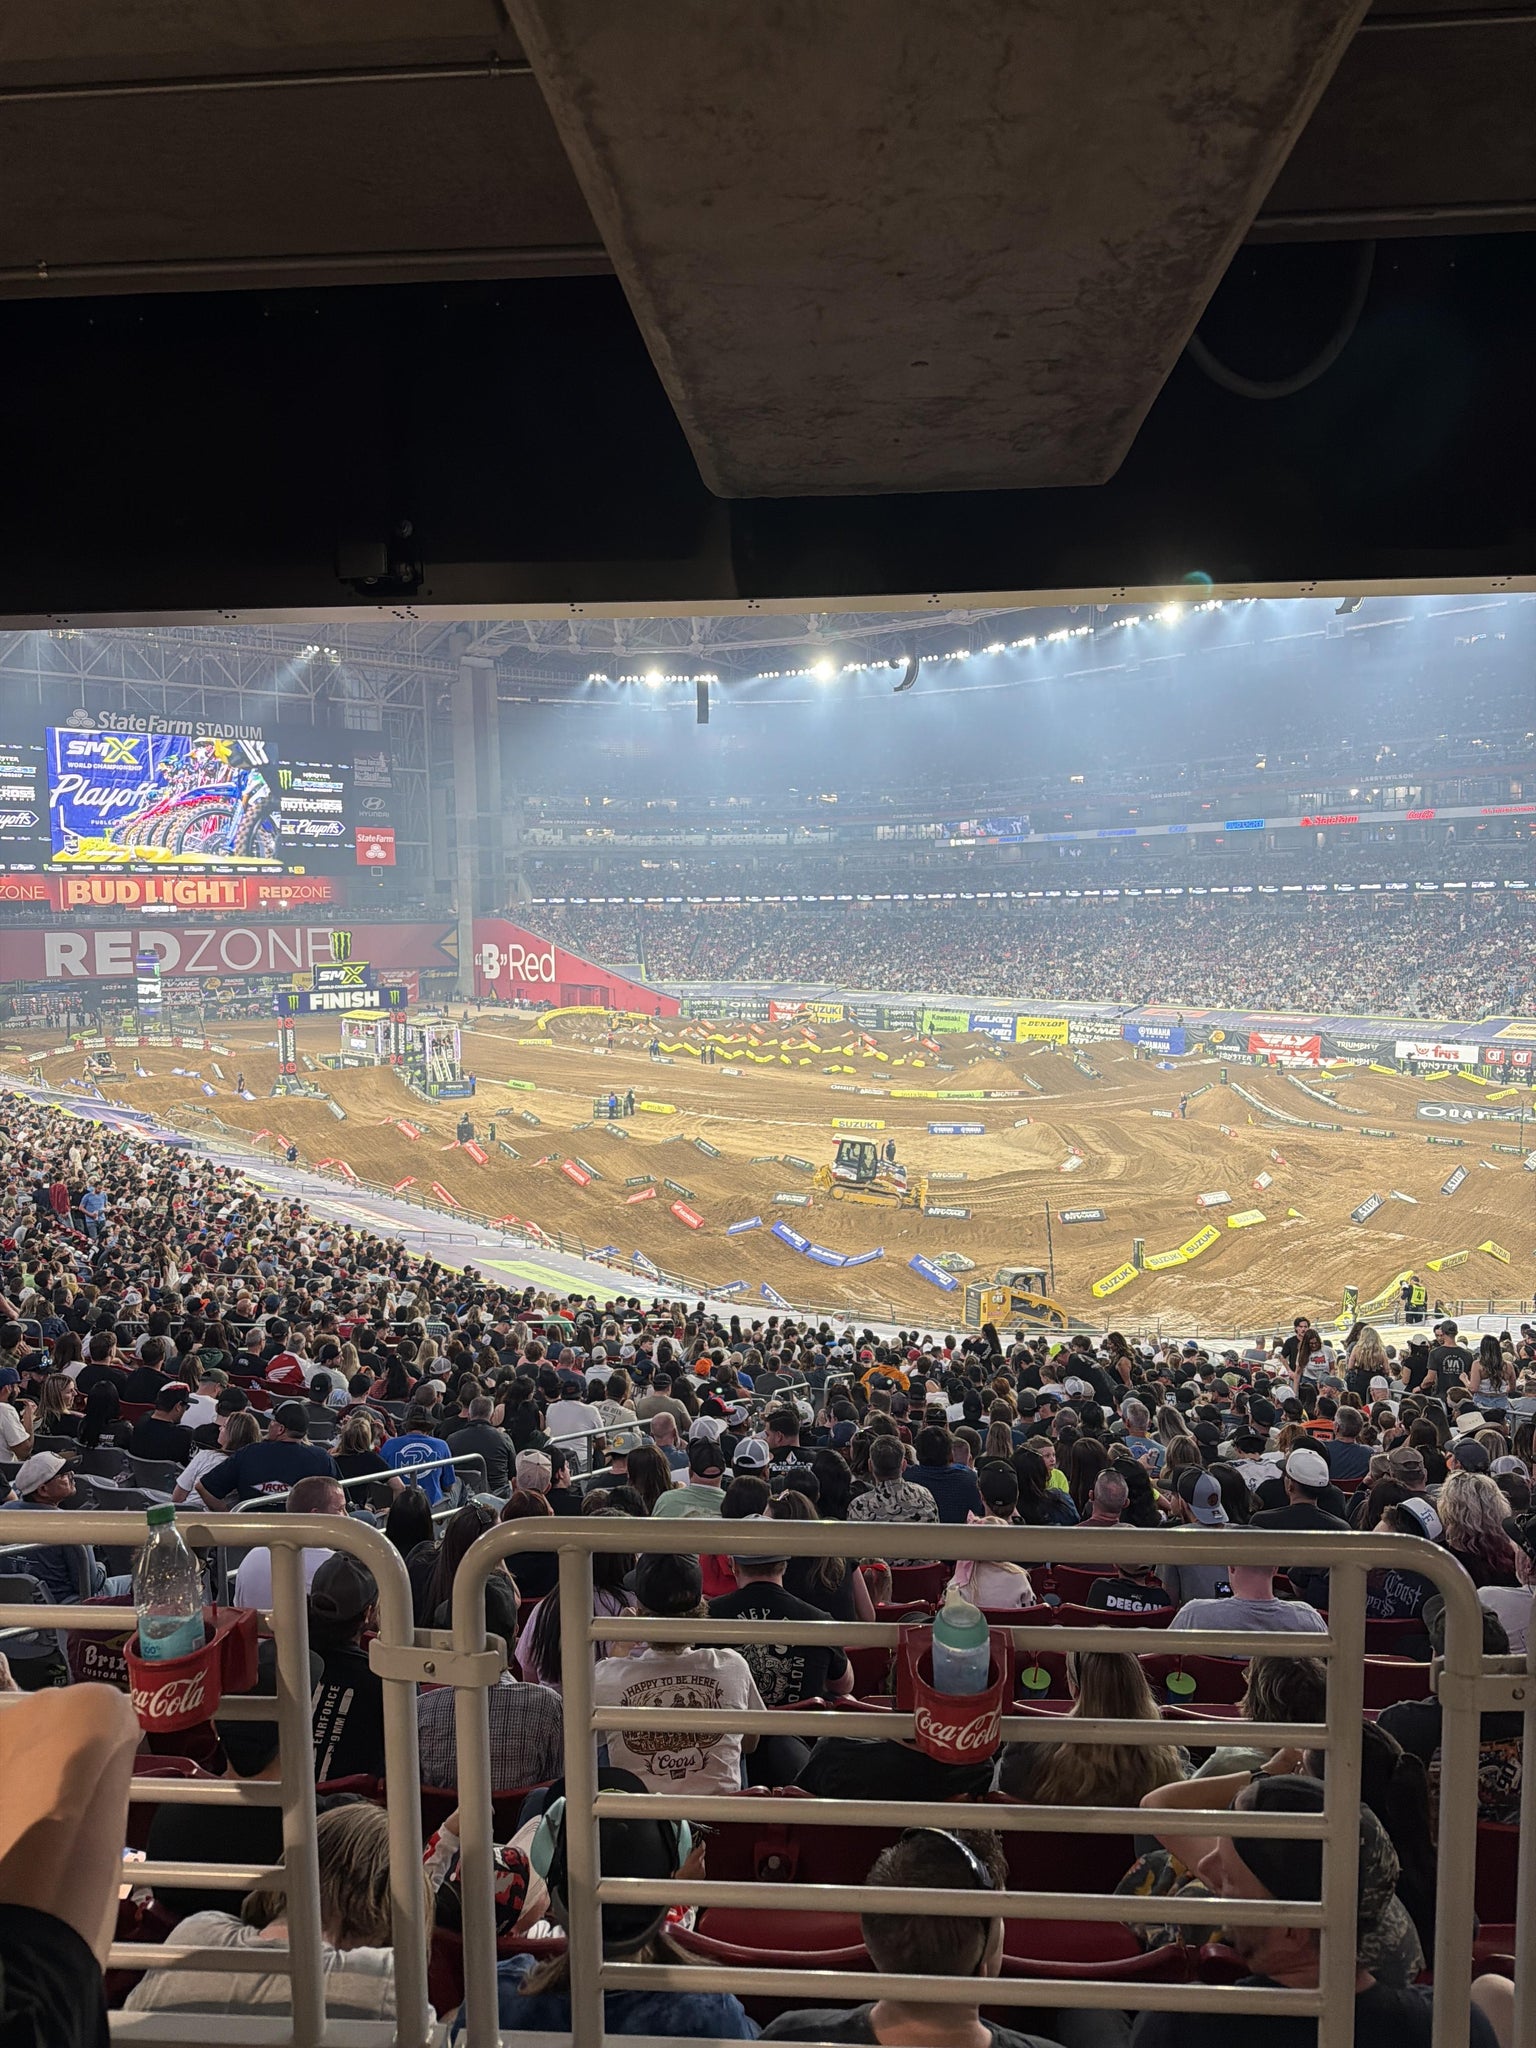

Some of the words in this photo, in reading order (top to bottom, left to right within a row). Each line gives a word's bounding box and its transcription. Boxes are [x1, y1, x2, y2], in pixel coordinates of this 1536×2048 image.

[97, 711, 193, 735] StateFarm
[196, 721, 262, 741] STADIUM
[66, 736, 140, 764] SMX
[93, 763, 143, 771] CHAMPIONSHIP
[1361, 774, 1383, 782] LARRY
[1385, 772, 1413, 780] WILSON
[1314, 814, 1359, 825] StateFarm
[296, 819, 340, 838] Playoffs
[357, 834, 394, 843] StateFarm
[67, 880, 140, 905] BUD
[259, 886, 332, 898] REDZONE
[44, 928, 334, 977] REDZONE
[509, 944, 556, 982] Red
[319, 966, 365, 984] SMX
[309, 990, 380, 1010] FINISH
[807, 1005, 842, 1015] SUZUKI
[931, 1014, 961, 1022] Kawasaki
[974, 1015, 1013, 1024] FALKEN
[1145, 1027, 1171, 1036] YAMAHA
[1258, 1033, 1315, 1046] FLY
[1336, 1041, 1370, 1050] TRIUMPH
[1432, 1045, 1460, 1060] fry's
[1487, 1051, 1503, 1061] QT
[1513, 1055, 1530, 1064] QT
[838, 1120, 878, 1129] SUZUKI
[568, 1166, 586, 1183] HONDA
[678, 1208, 698, 1225] HONDA
[1235, 1213, 1261, 1226] SUZUKI
[779, 1223, 806, 1244] FALKEN
[1186, 1228, 1216, 1254] SUZUKI
[1151, 1253, 1182, 1266] SUZUKI
[1442, 1253, 1467, 1268] SUZUKI
[918, 1259, 952, 1283] FALKEN
[1100, 1267, 1133, 1292] SUZUKI
[992, 1295, 1003, 1303] CAT
[1415, 1292, 1422, 1300] 4
[1359, 1299, 1387, 1316] SUZUKI
[1447, 1359, 1460, 1369] VA
[261, 1481, 289, 1492] JACKS
[1106, 1595, 1164, 1612] DEEGAN
[82, 1666, 117, 1679] CUSTOM
[131, 1667, 209, 1718] ca-Cola
[627, 1680, 658, 1698] HAPPY
[661, 1677, 673, 1686] TO
[676, 1675, 689, 1685] BE
[691, 1675, 717, 1689] HERE
[914, 1702, 1001, 1751] Coca-Cola
[657, 1754, 696, 1770] Coors
